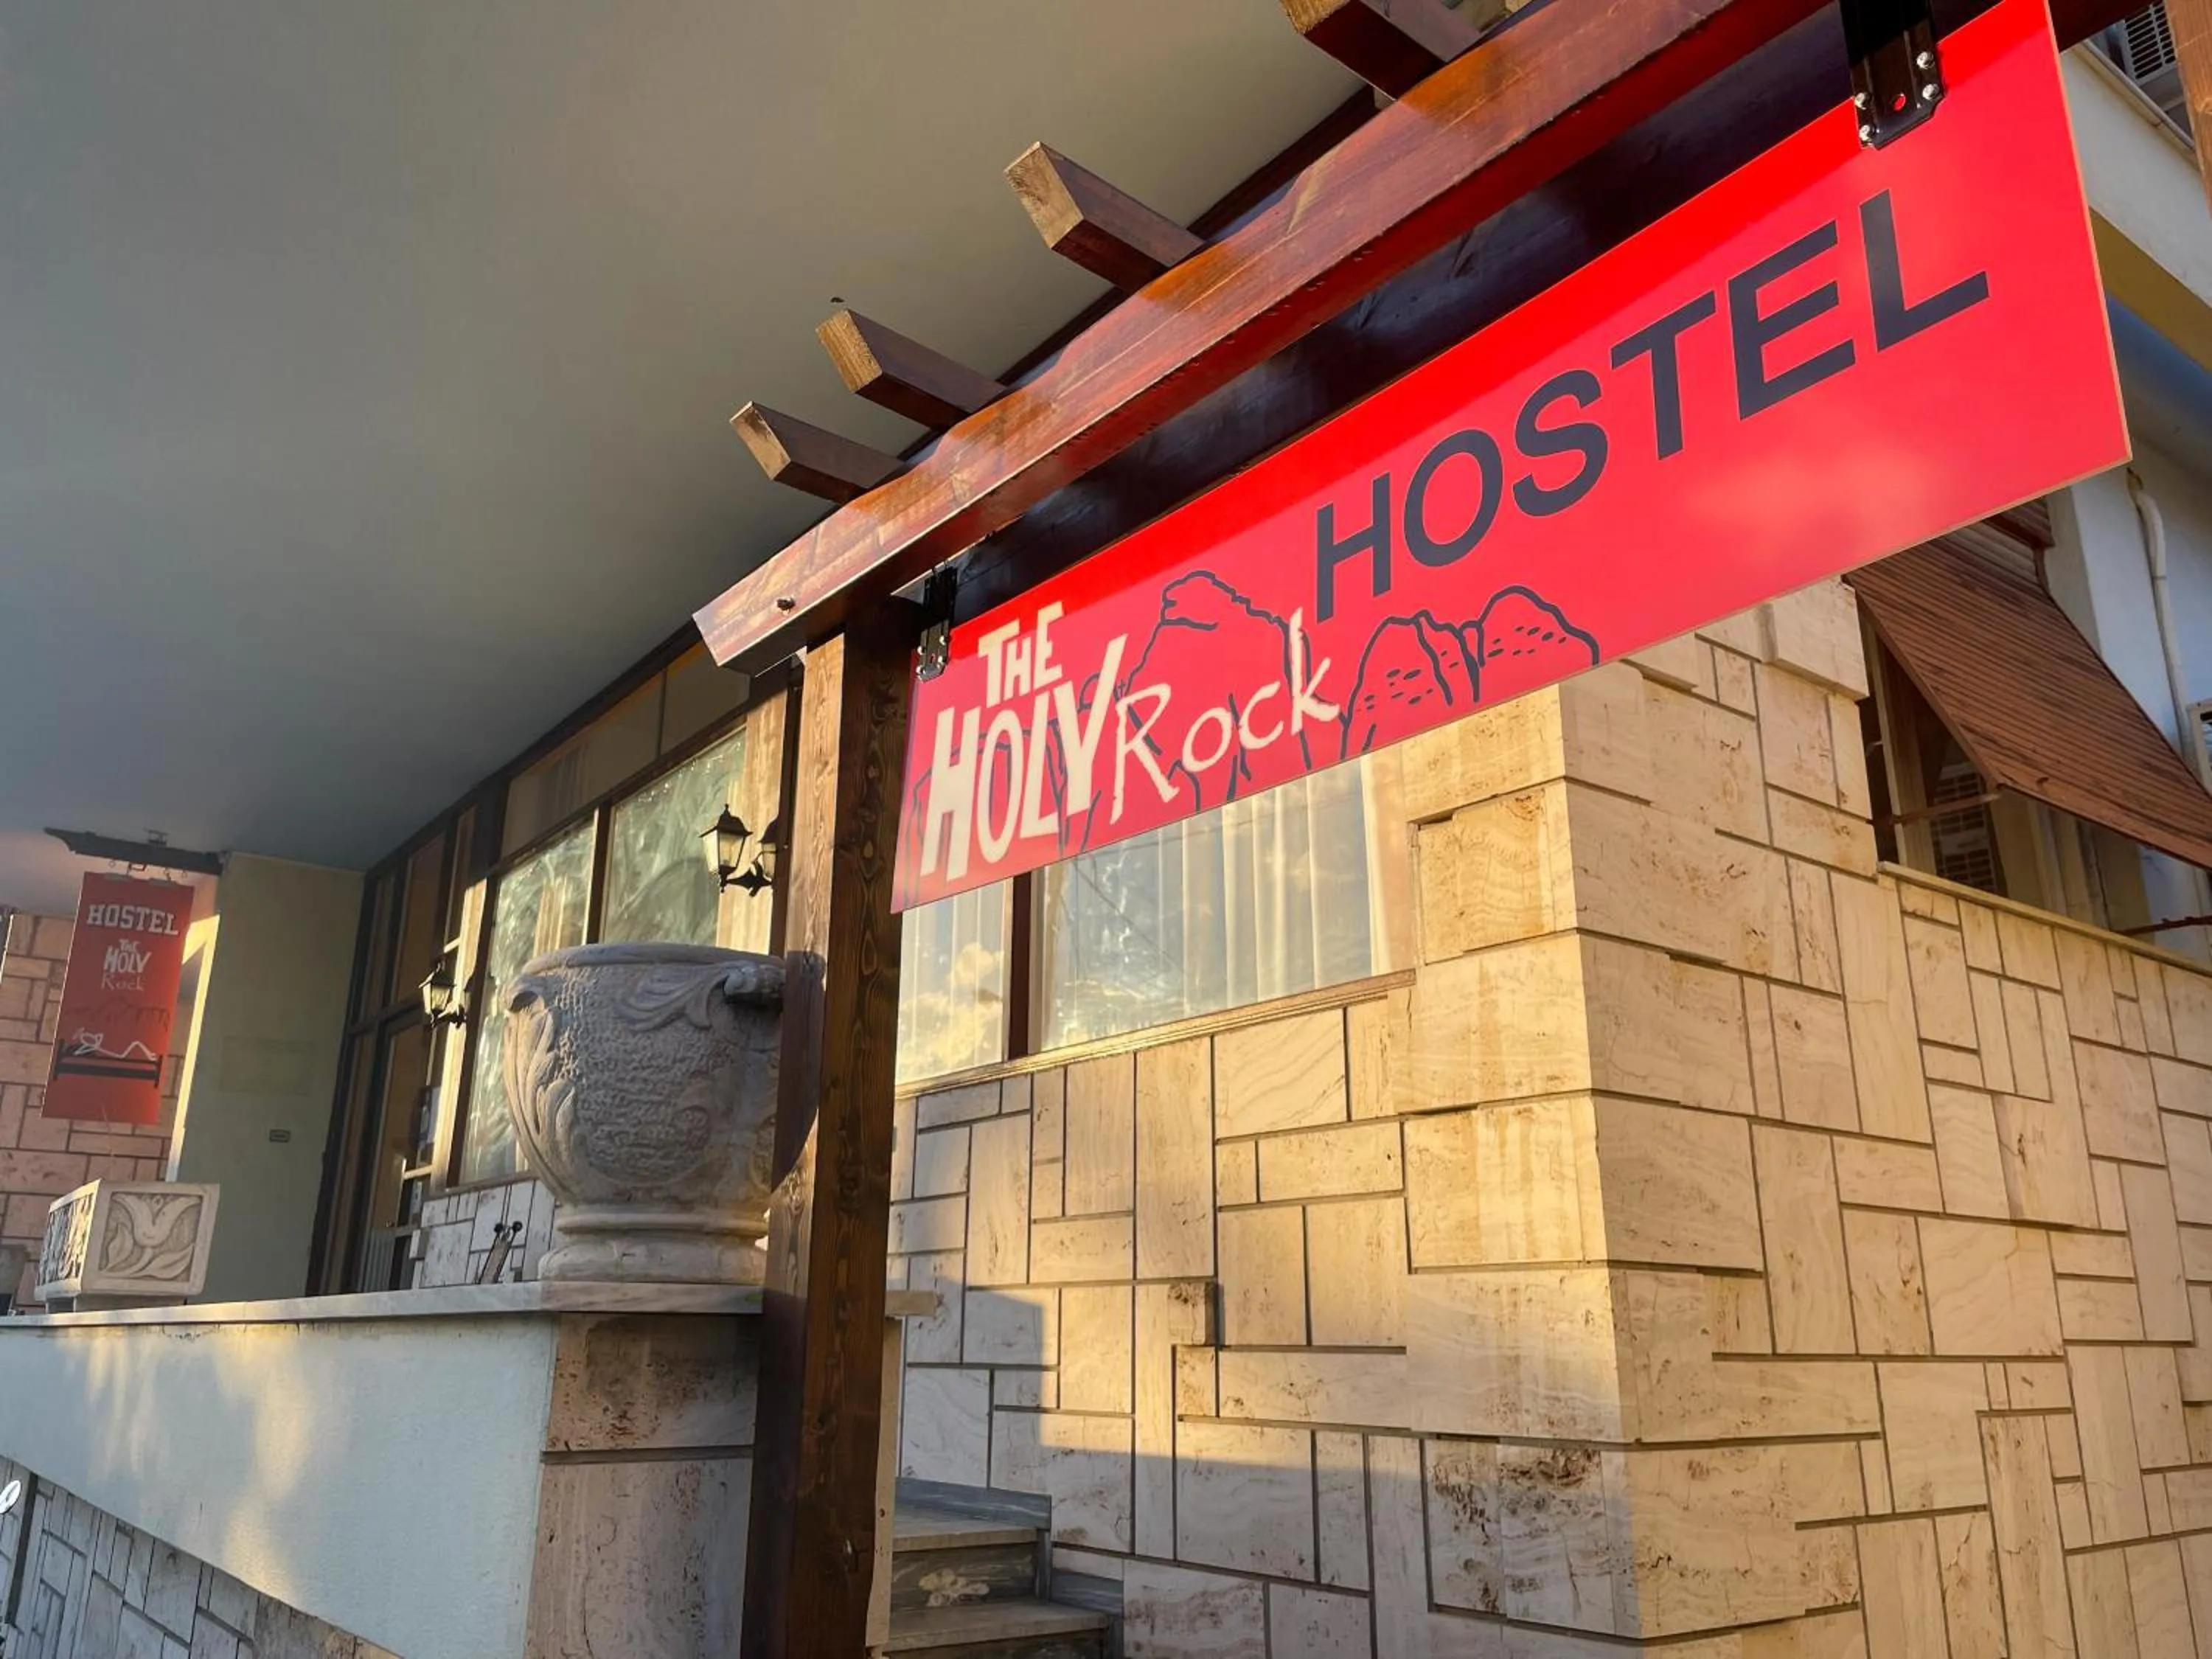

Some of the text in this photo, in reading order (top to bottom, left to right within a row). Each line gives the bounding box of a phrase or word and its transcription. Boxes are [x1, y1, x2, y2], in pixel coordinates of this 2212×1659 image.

[1315, 189, 1989, 622] HOSTEL
[978, 602, 1064, 709] THE
[919, 608, 1340, 881] HOLY Rock
[86, 904, 178, 935] HOSTEL
[104, 945, 152, 973] HOLY
